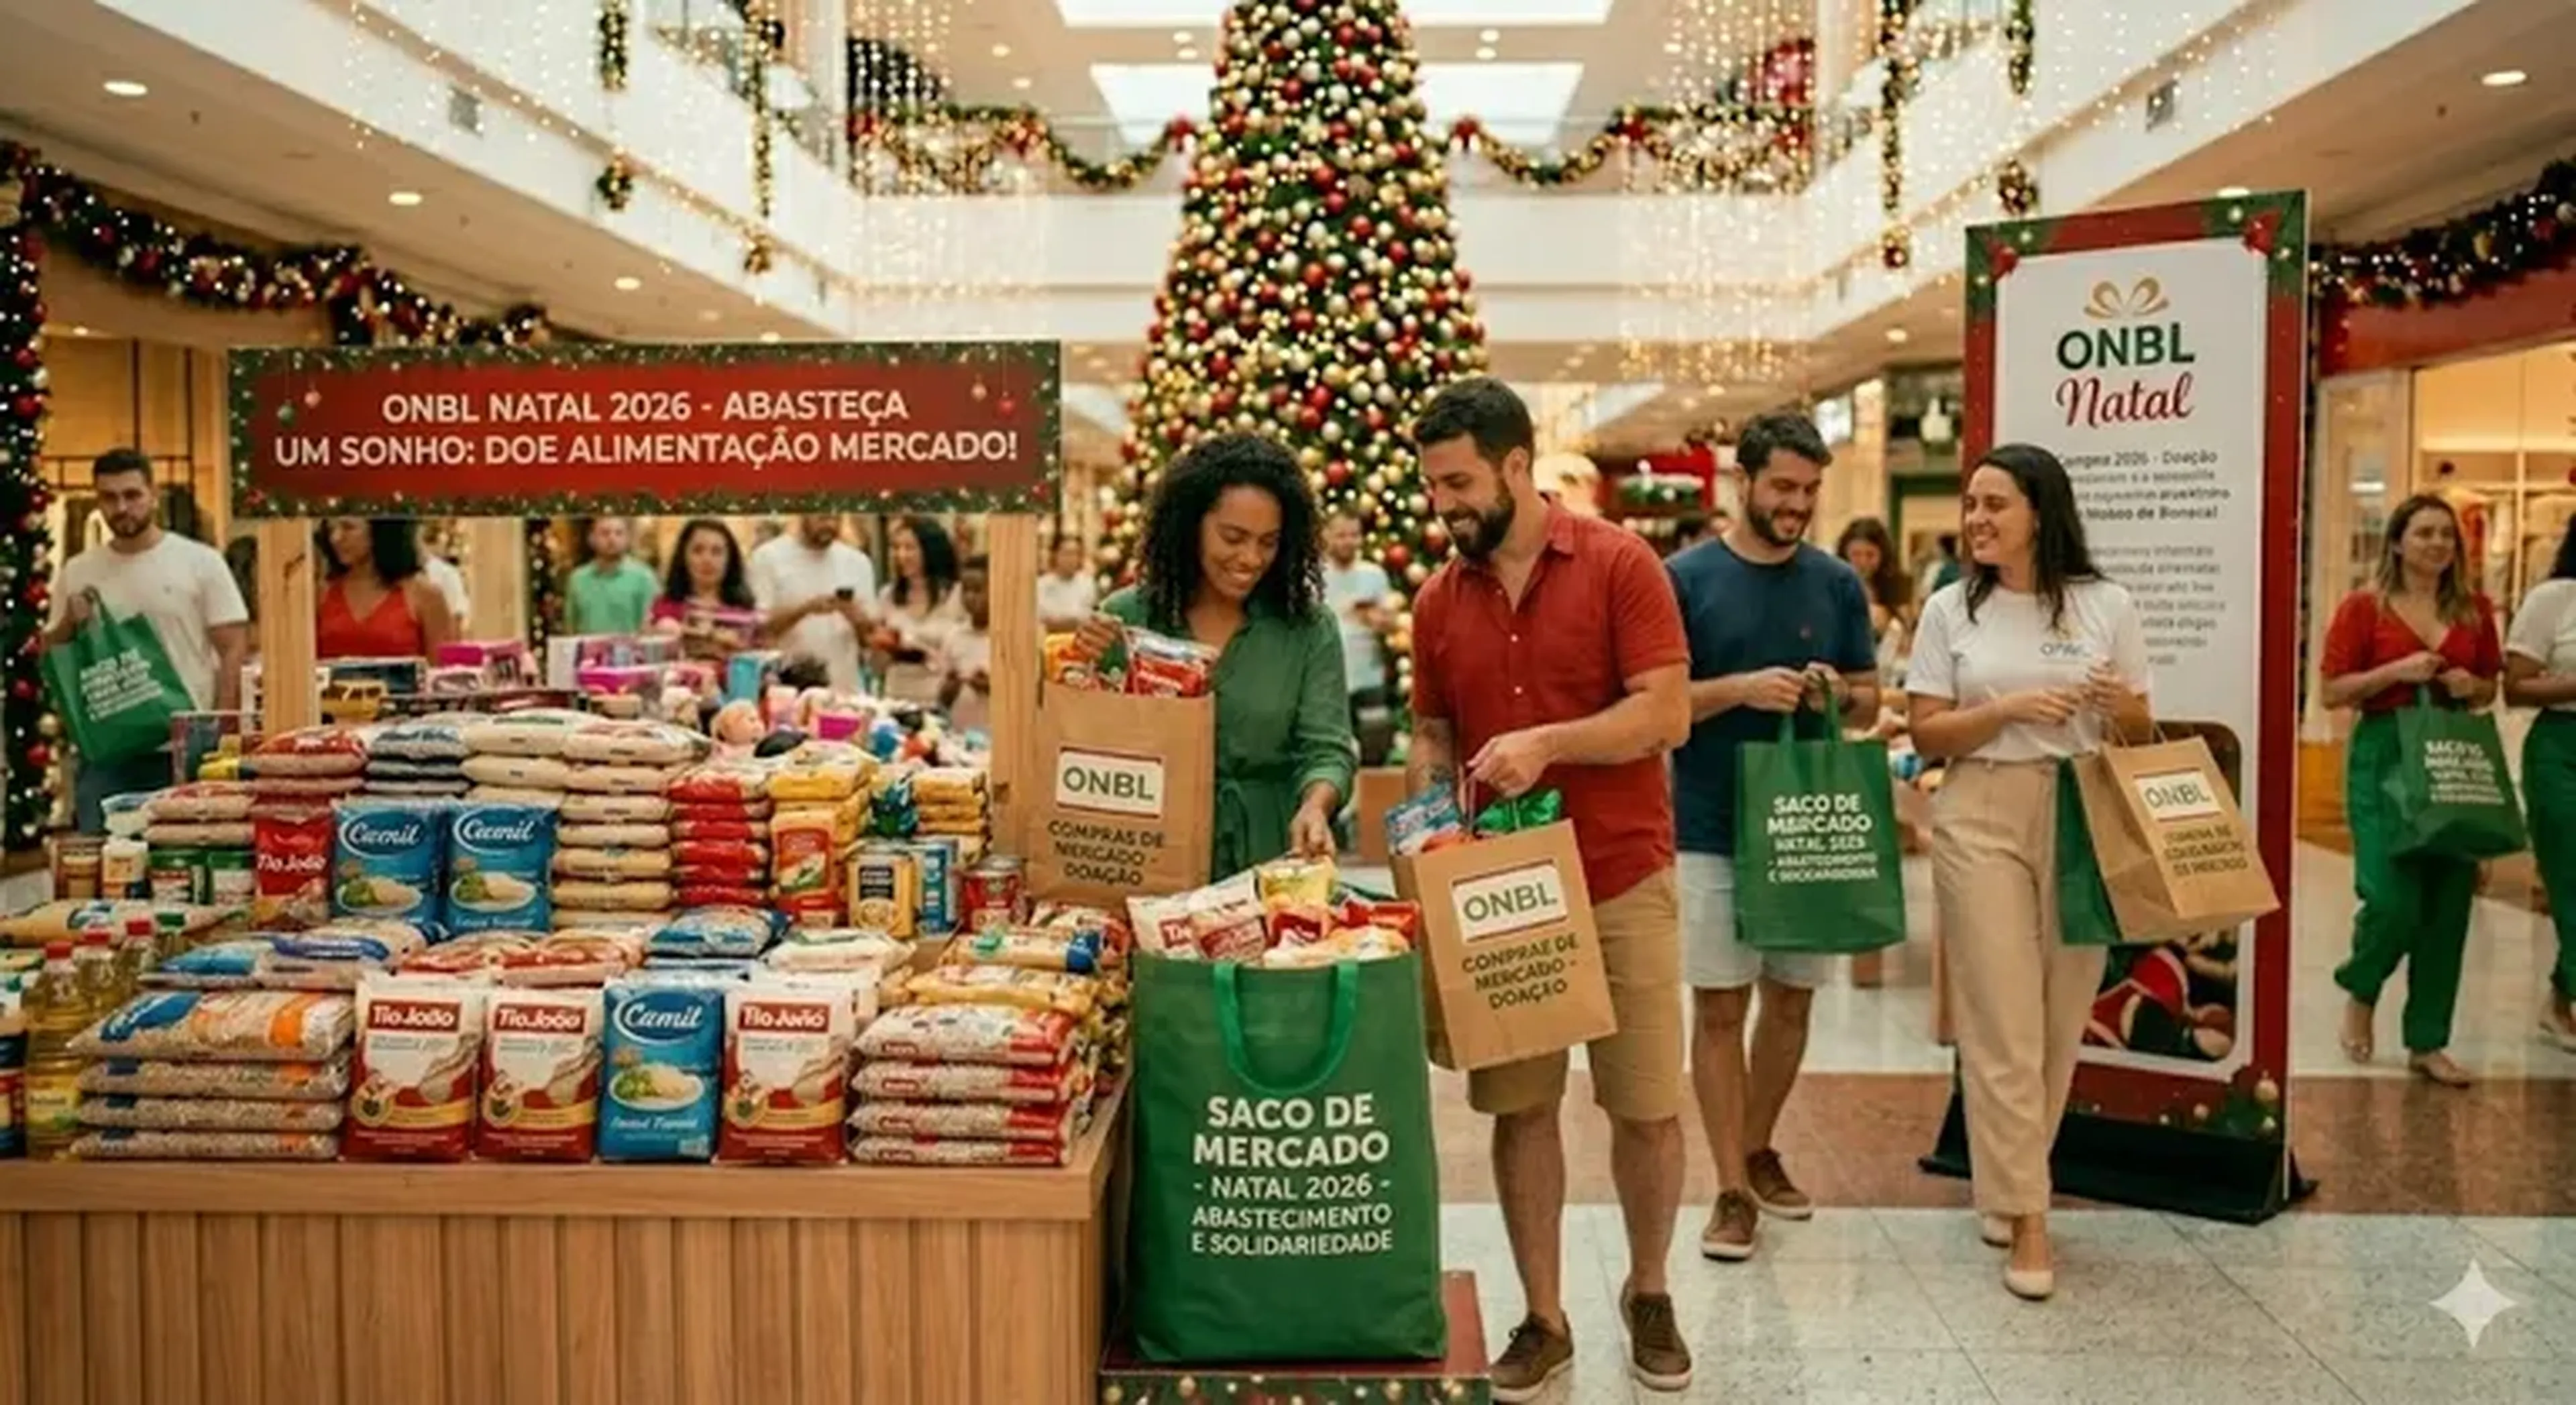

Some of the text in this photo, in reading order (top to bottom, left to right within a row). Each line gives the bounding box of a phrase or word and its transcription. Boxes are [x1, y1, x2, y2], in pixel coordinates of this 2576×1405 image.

[2057, 322, 2196, 370] ONBL
[382, 394, 480, 423] ONBL
[489, 392, 600, 422] NATAL
[610, 391, 692, 422] 2026
[722, 390, 909, 427] ABASTEÇA
[2056, 371, 2195, 429] Natal
[275, 425, 1017, 470] UM SONHO: DOE ALIMENTAÇÃO MERCADO!
[1063, 766, 1154, 800] ONBL
[2145, 783, 2211, 808] ONBL
[1773, 793, 1861, 814] SACO DE
[1464, 881, 1558, 921] ONBL
[623, 1003, 703, 1028] Camil
[1208, 1093, 1373, 1129] SACO DE
[1194, 1130, 1390, 1168] MERCADO
[1212, 1176, 1298, 1199] NATAL
[1306, 1172, 1373, 1199] 2026
[1192, 1202, 1393, 1229] ABASTECIMENTO
[1192, 1230, 1393, 1255] E SOLIDARIEDADE
